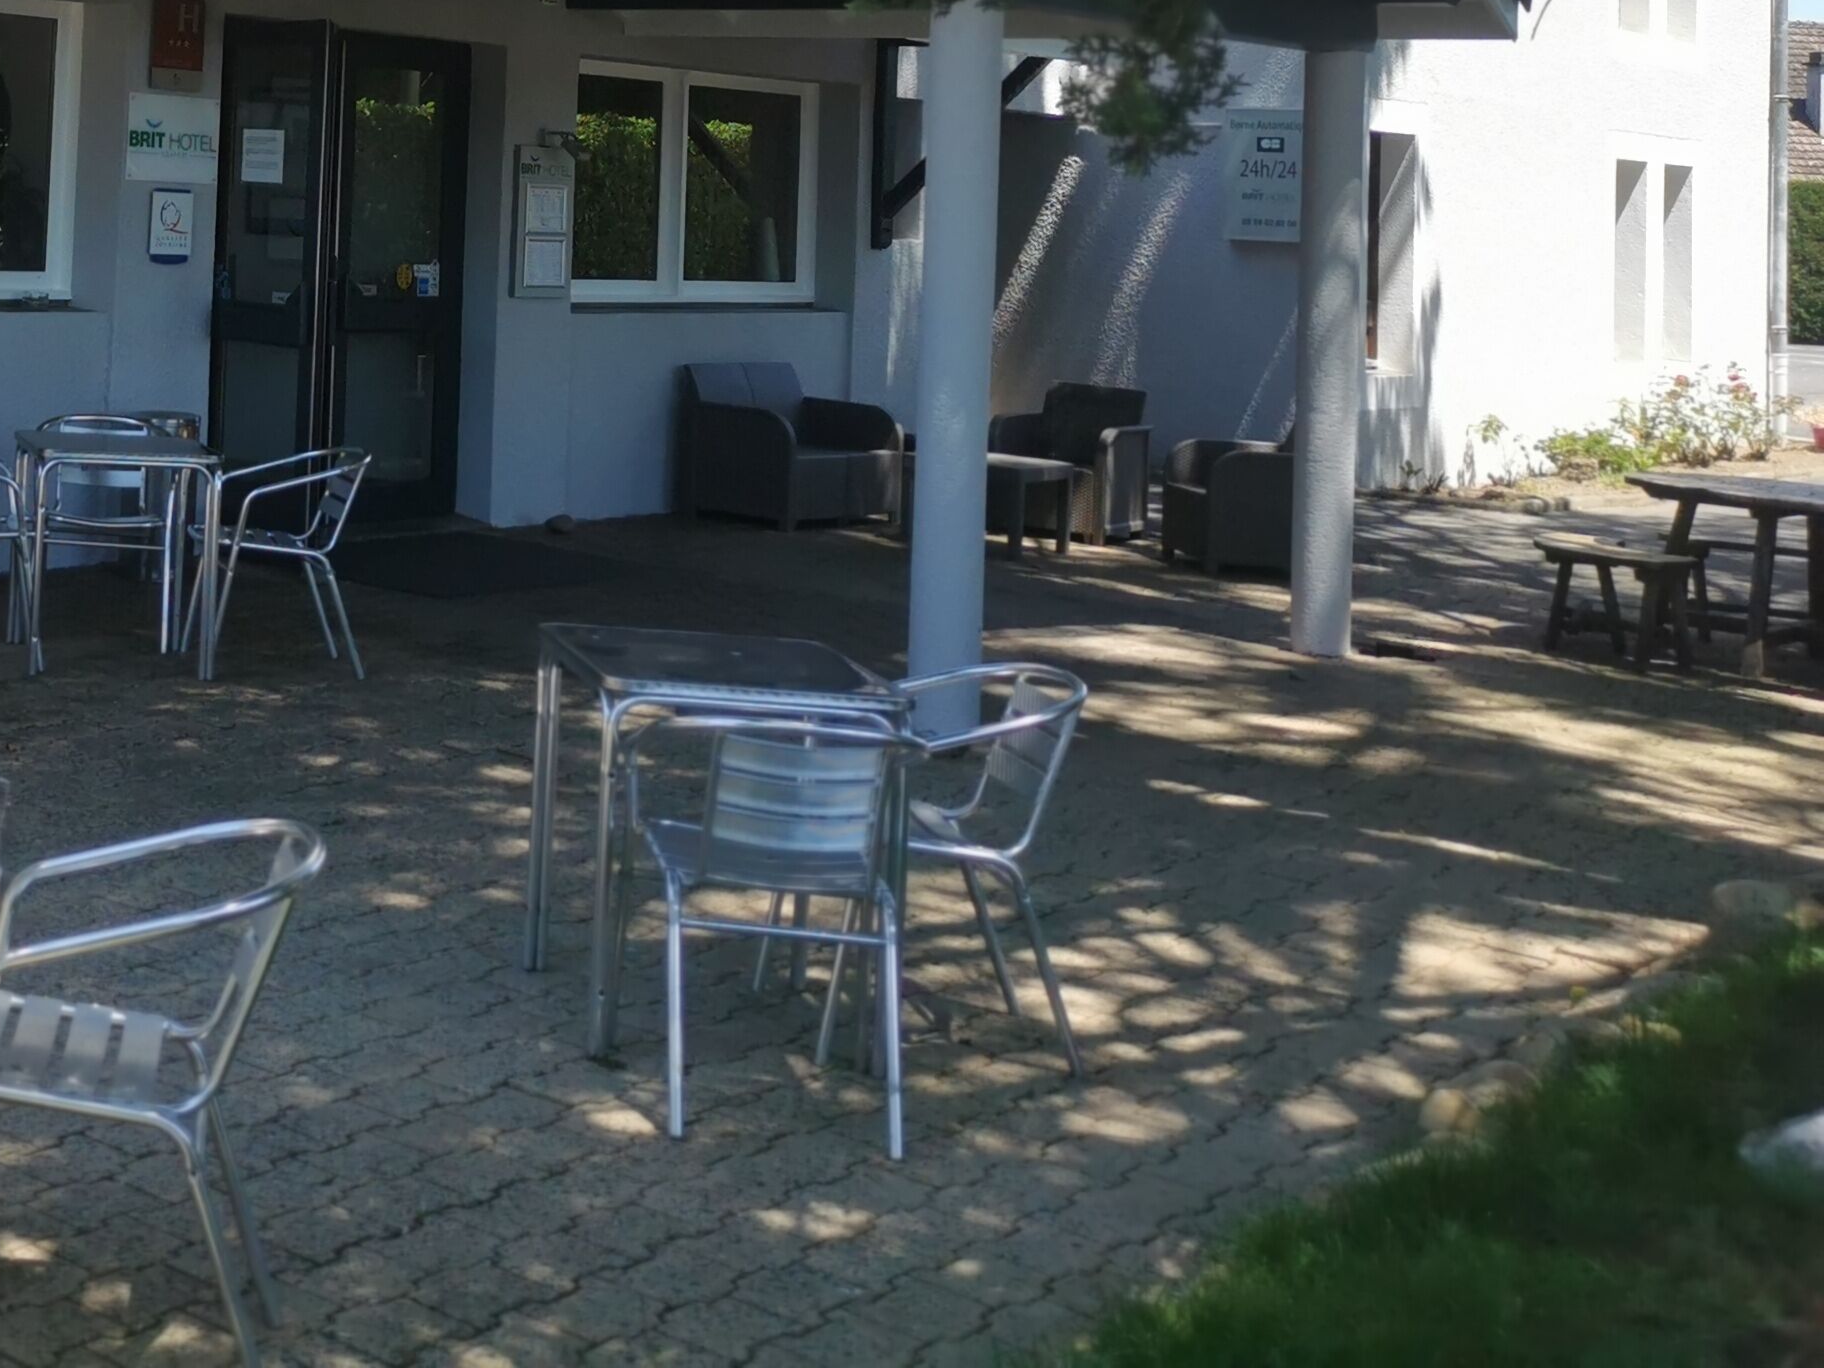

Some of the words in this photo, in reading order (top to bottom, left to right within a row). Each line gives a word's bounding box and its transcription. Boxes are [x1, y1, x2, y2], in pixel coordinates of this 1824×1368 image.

[1256, 120, 1303, 133] Automatiq
[129, 130, 166, 149] BRIT
[168, 133, 217, 153] HOTEL
[521, 162, 542, 177] BRIT
[1240, 159, 1297, 179] 24h/24
